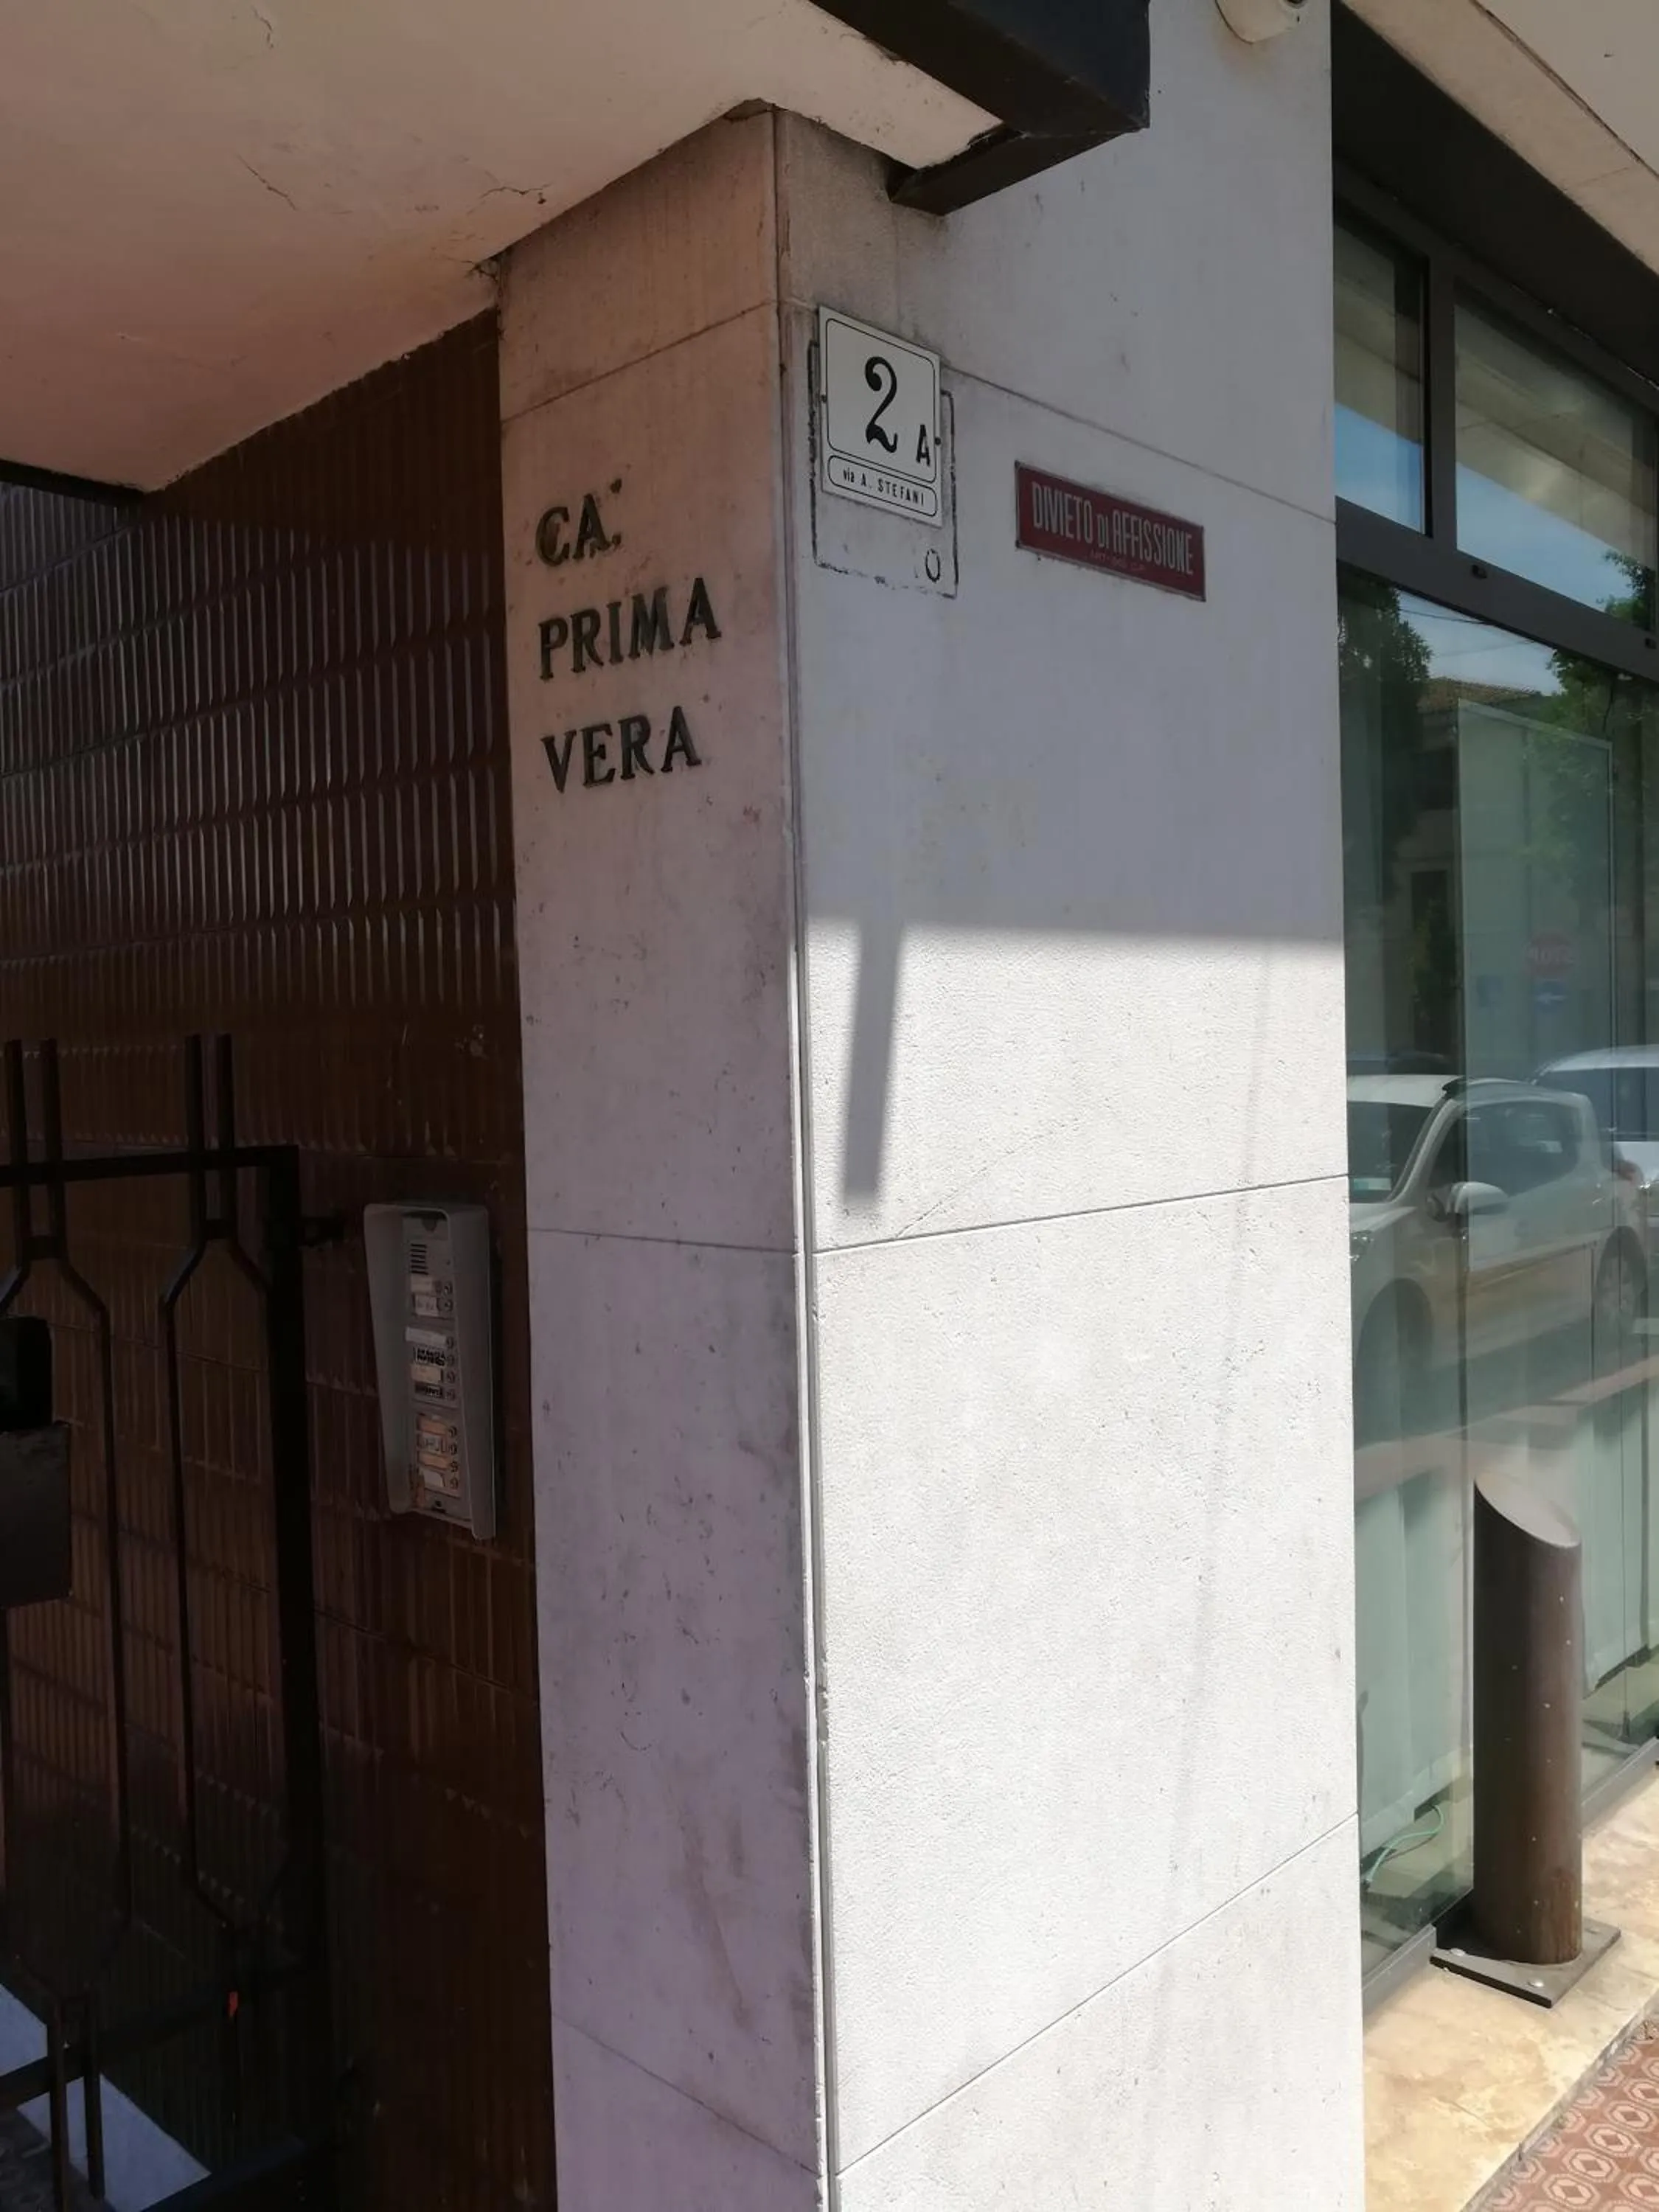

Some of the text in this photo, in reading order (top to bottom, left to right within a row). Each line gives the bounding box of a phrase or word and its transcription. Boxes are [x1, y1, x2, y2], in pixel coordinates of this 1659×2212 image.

[864, 356, 931, 467] 2 A
[877, 478, 925, 507] STEFANI
[1031, 481, 1094, 544] DIVIETO
[1112, 509, 1194, 576] AFFISSIONE
[538, 577, 722, 681] PRIMA
[540, 706, 702, 793] VERA
